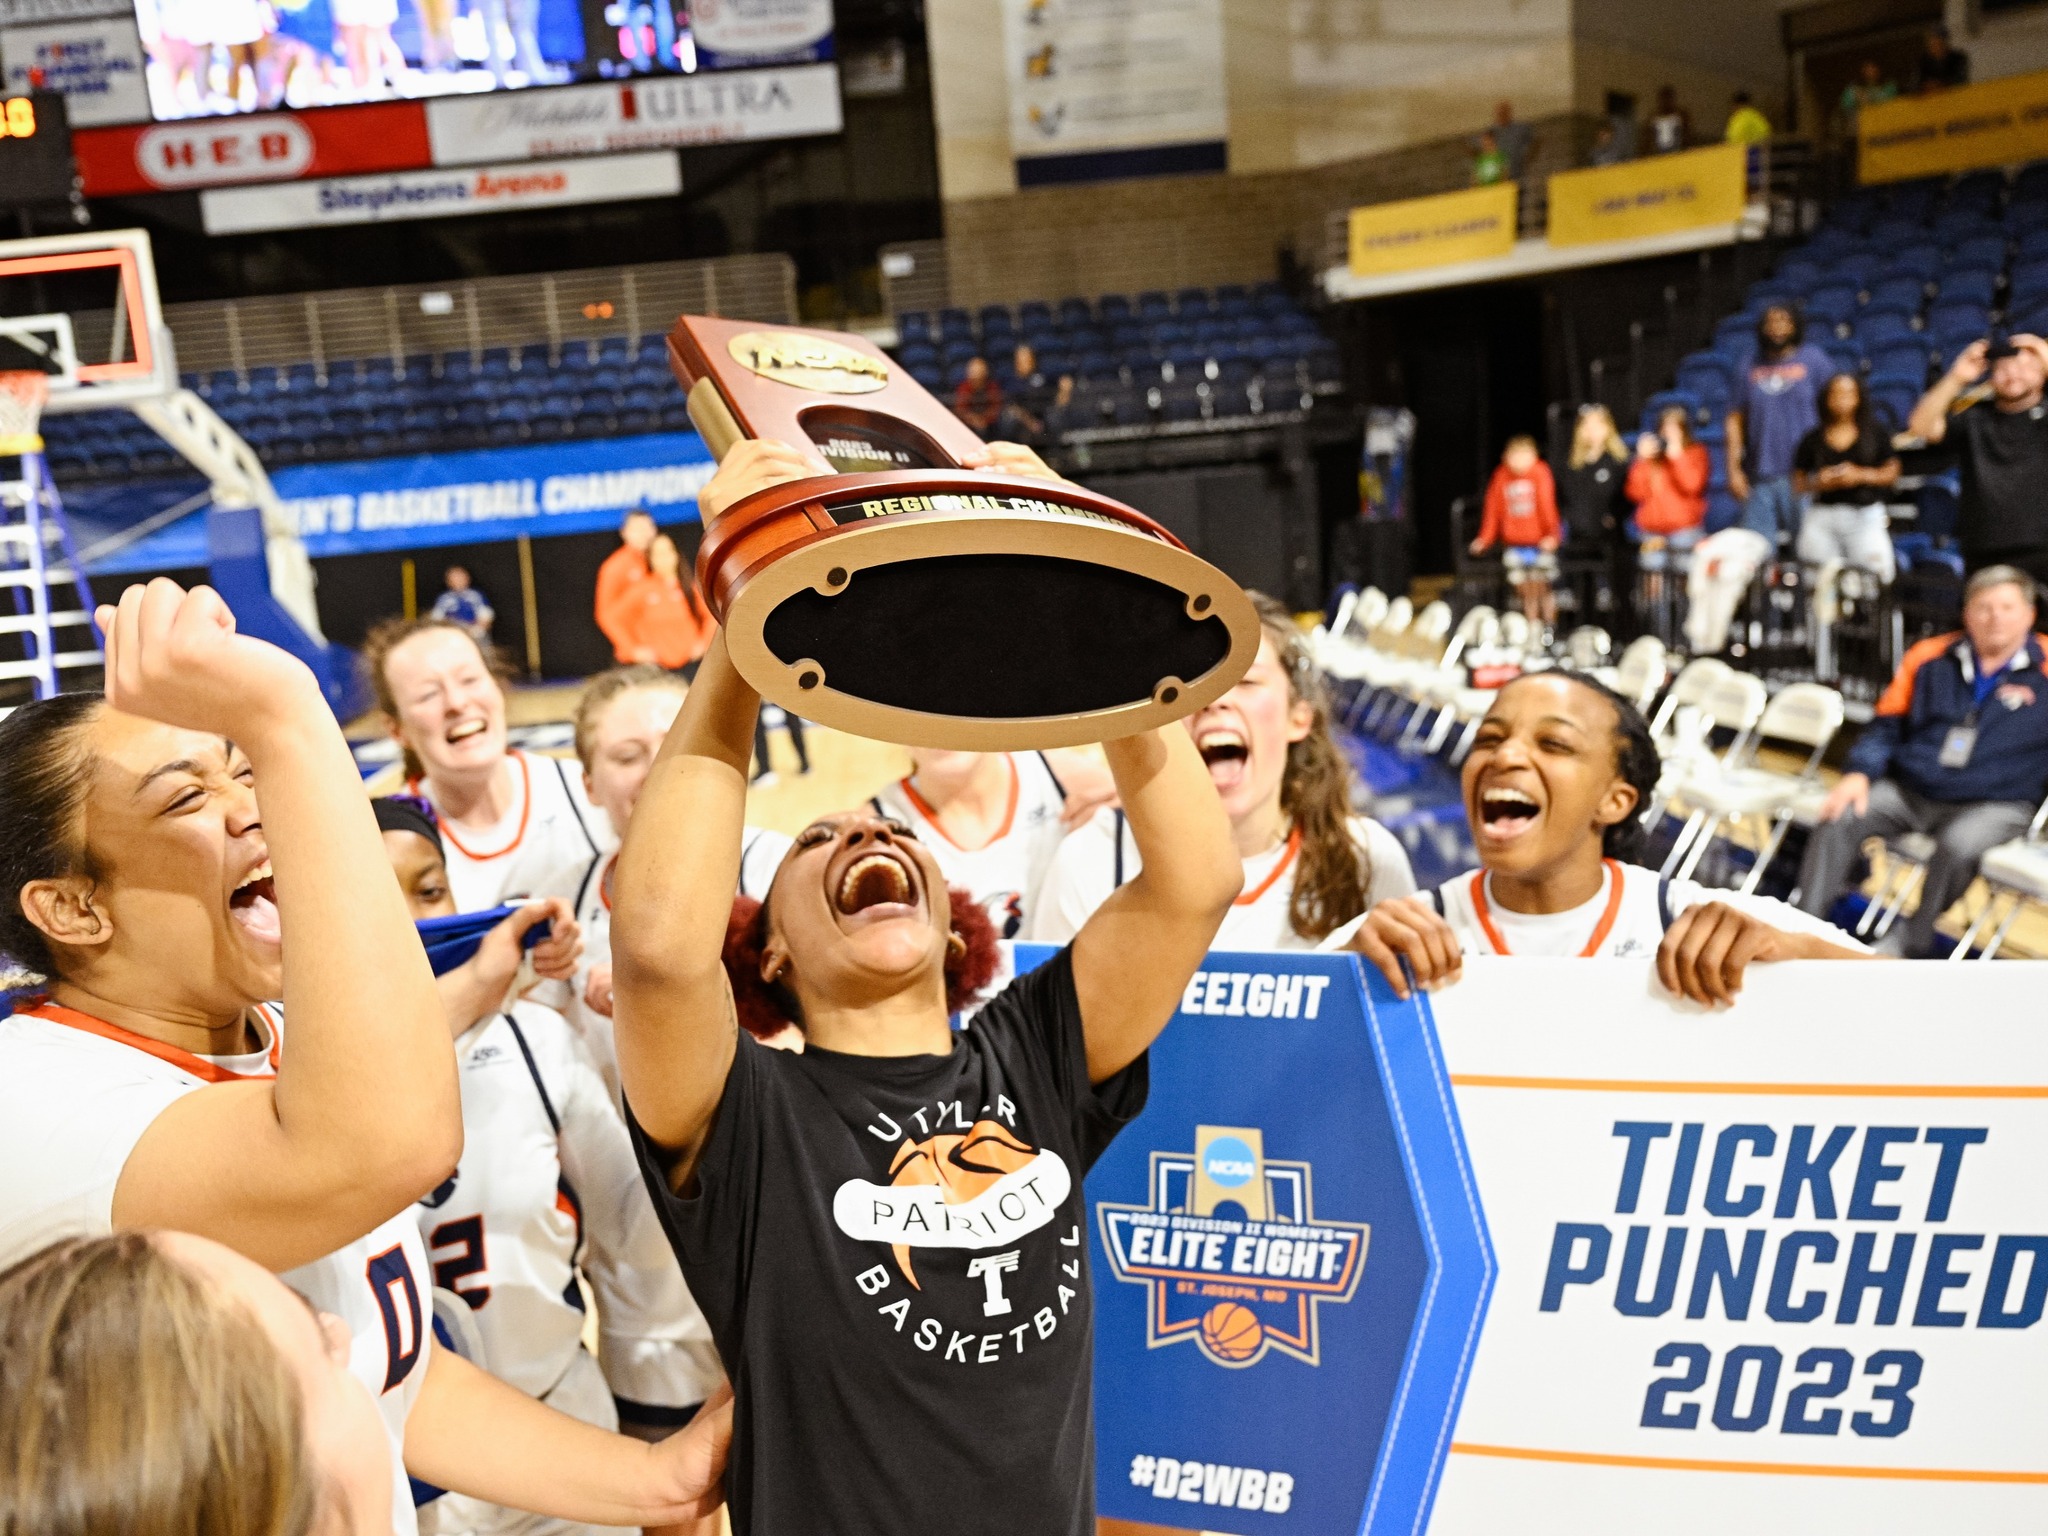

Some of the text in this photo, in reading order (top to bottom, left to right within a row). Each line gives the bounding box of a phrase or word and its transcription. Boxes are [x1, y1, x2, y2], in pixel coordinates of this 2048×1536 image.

[646, 77, 793, 122] ULTRA
[357, 477, 540, 533] BASKETBALL
[861, 494, 1006, 518] REGIONAL
[1206, 1159, 1254, 1178] NCAA
[1611, 1120, 1989, 1223] TICKET
[873, 1176, 1047, 1238] PATRIOT
[1129, 1212, 1336, 1242] 2023 DIVISION II WOMEN'S
[1129, 1226, 1344, 1281] ELITE EIGHT
[1538, 1221, 2048, 1330] PUNCHED
[855, 1225, 1080, 1364] BASKETBALL
[1176, 1281, 1200, 1296] ST.
[1639, 1341, 1925, 1438] 2023
[1129, 1454, 1295, 1514] #D2WBB
